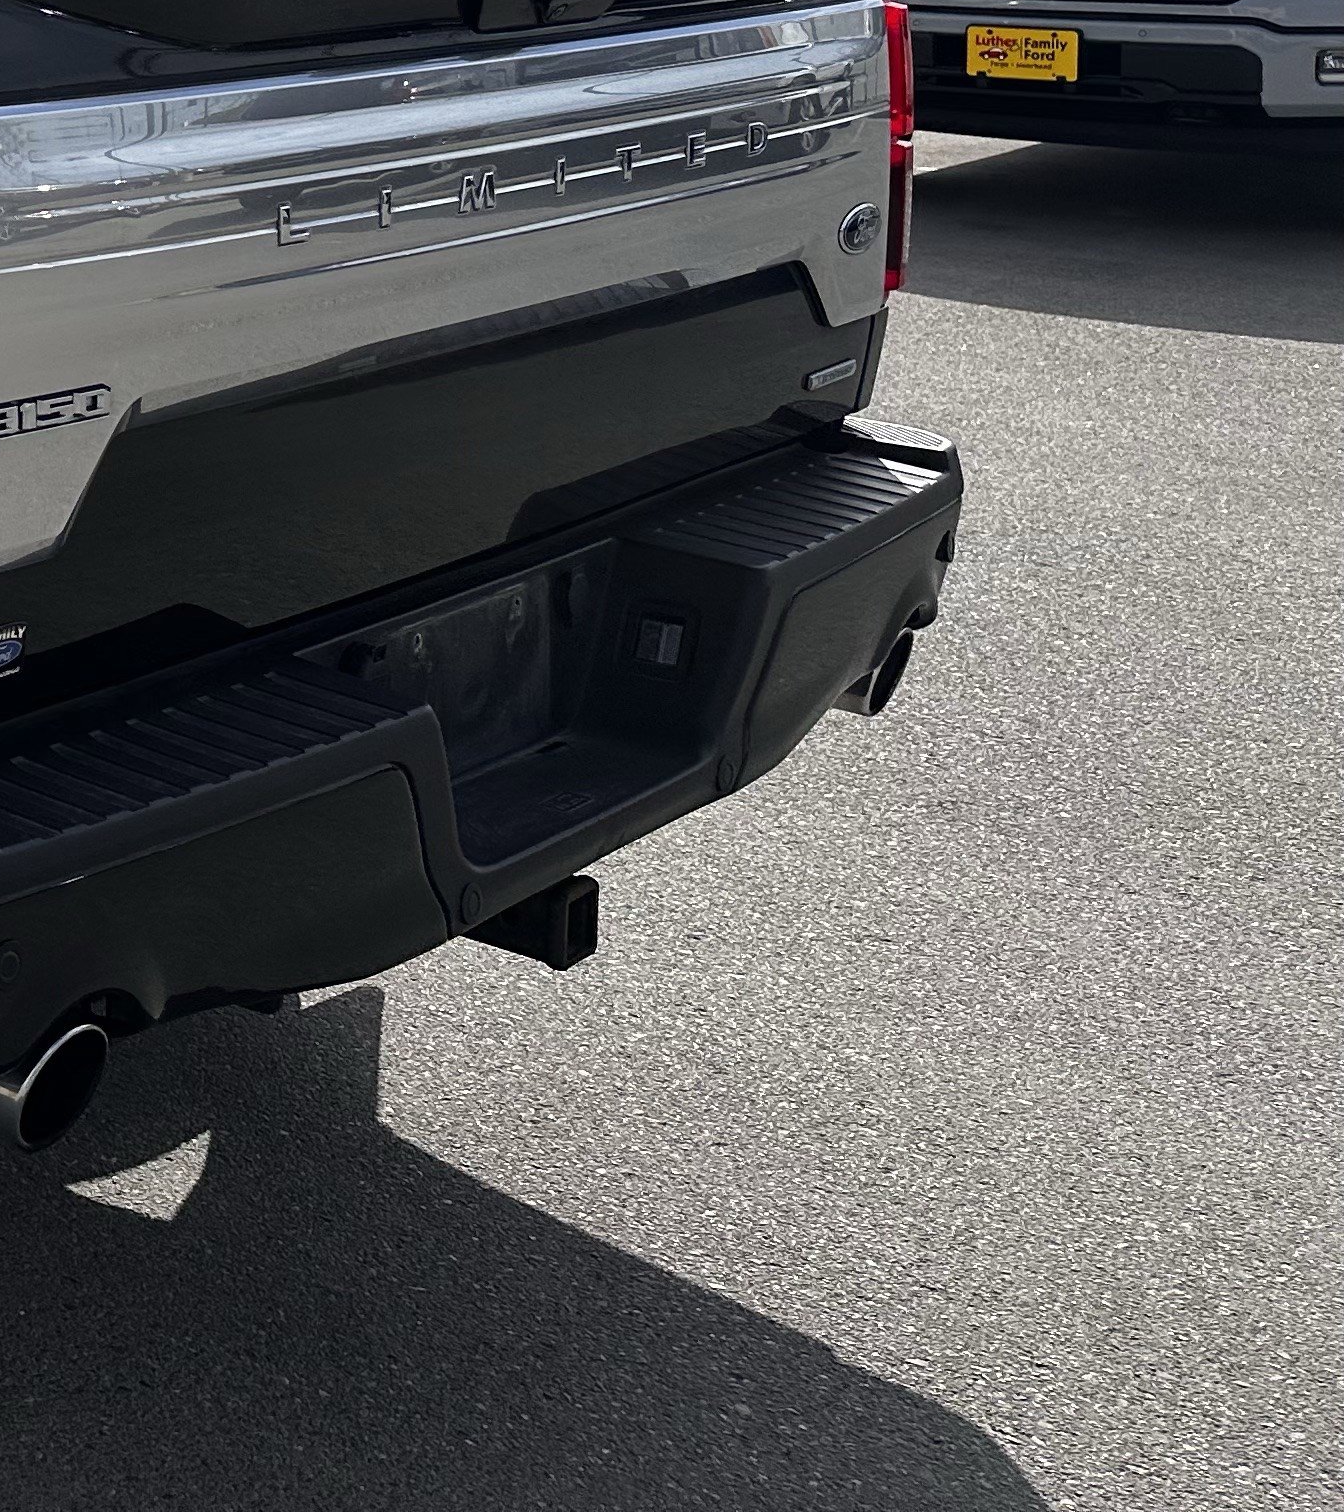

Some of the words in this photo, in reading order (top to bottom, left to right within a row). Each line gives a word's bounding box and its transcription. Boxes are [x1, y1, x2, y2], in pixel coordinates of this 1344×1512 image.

[975, 34, 1017, 48] Luther
[1024, 37, 1068, 52] Family
[1024, 50, 1055, 62] Ford
[277, 121, 769, 247] LIMITED
